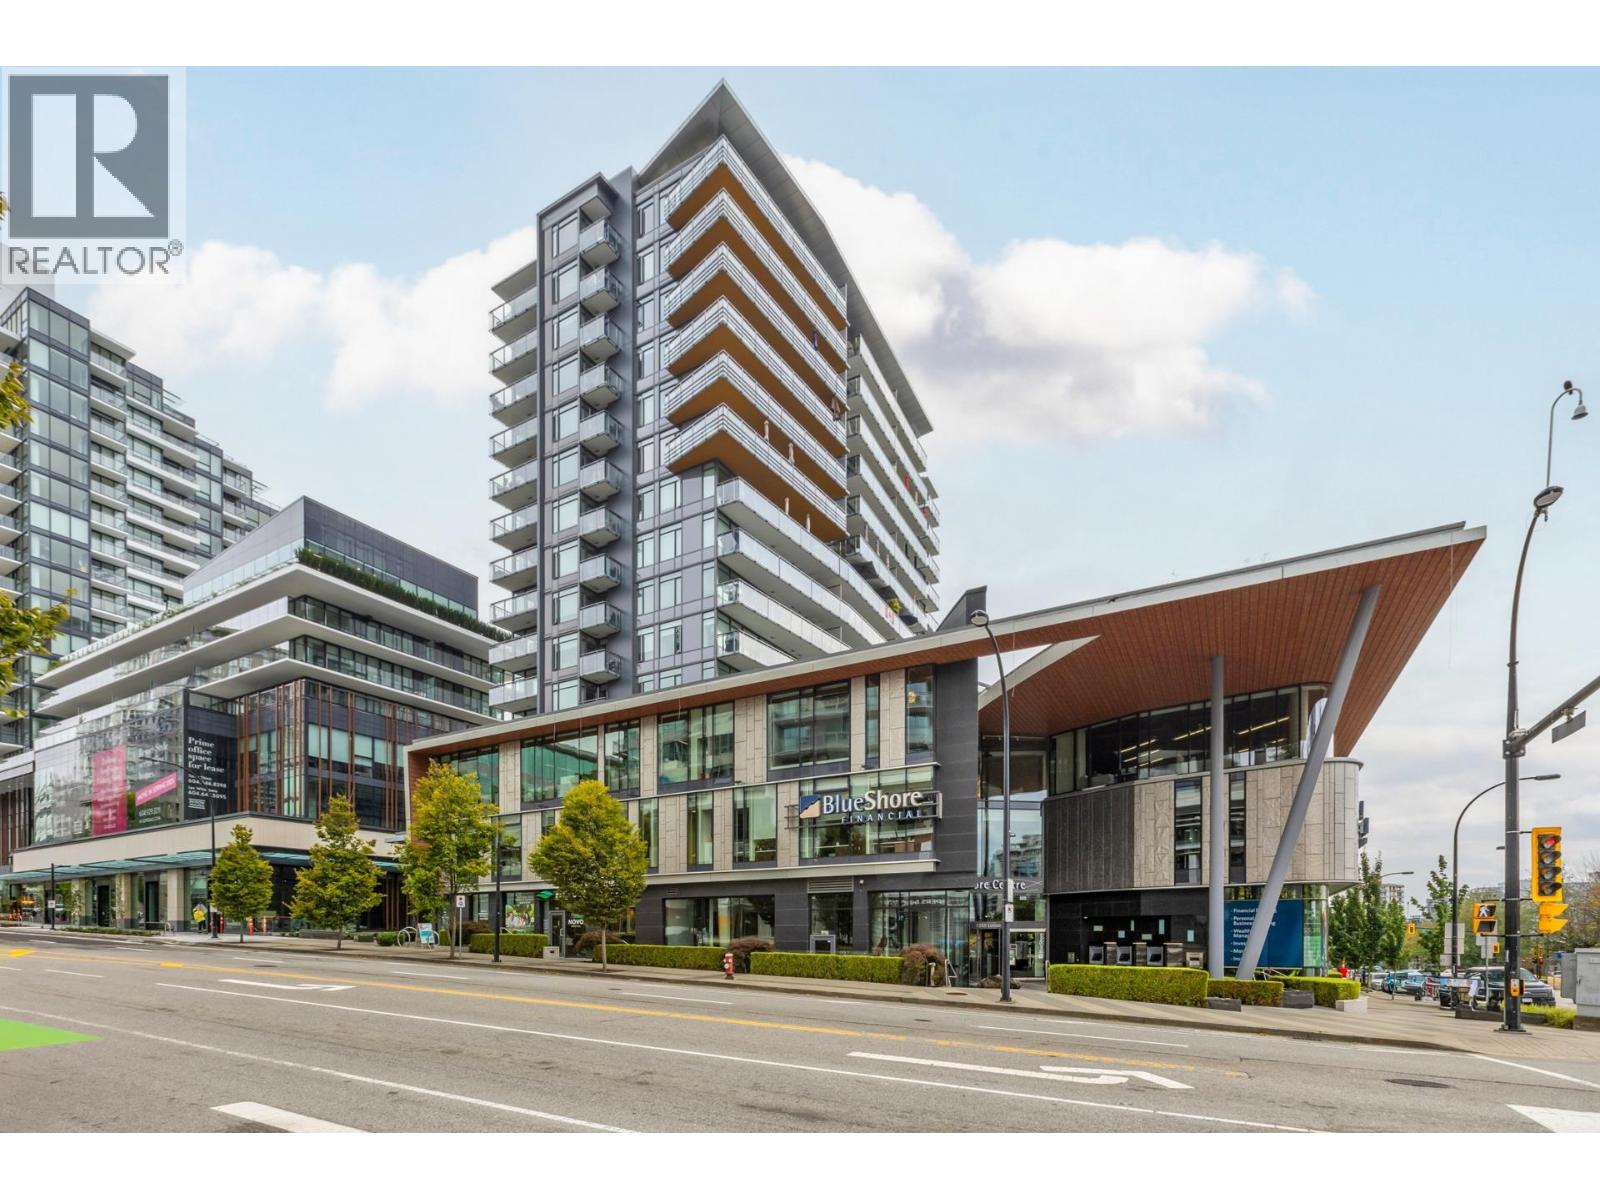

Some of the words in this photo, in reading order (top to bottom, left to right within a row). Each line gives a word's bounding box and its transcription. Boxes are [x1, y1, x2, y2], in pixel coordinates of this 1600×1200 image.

[188, 736, 215, 748] Prime
[187, 746, 212, 755] office
[187, 754, 212, 763] space
[188, 761, 202, 770] for
[203, 763, 224, 773] lease
[822, 790, 924, 814] BlueShore
[841, 809, 922, 824] FINANCIAL
[992, 879, 1026, 890] Cere
